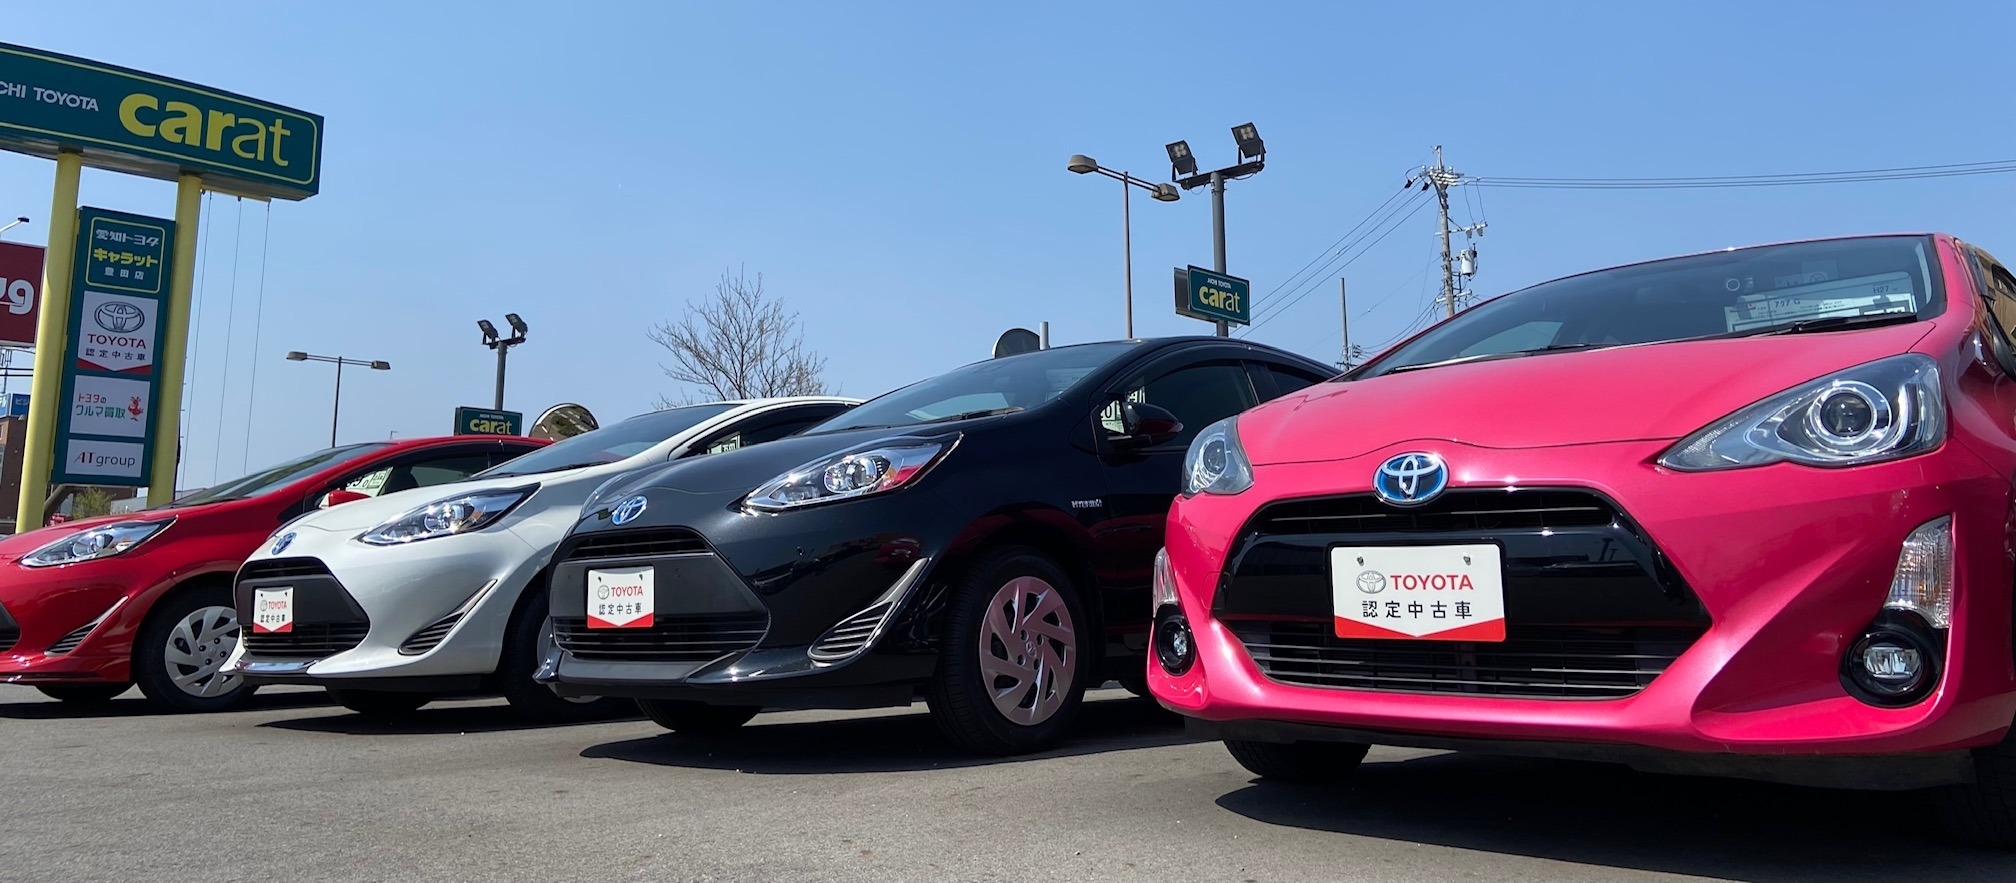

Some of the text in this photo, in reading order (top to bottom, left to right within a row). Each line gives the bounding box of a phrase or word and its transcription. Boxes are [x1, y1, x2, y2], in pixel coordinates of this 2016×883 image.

[33, 87, 99, 112] TOYOTA
[118, 93, 291, 167] carat
[96, 229, 159, 247] 愛知トヨタ
[94, 248, 158, 267] キャラット
[1199, 285, 1240, 313] carat
[87, 333, 147, 350] TOYOTA
[85, 348, 146, 361] 認定中古車
[78, 393, 107, 404] トヨタの
[75, 405, 126, 419] クルマ買取
[470, 418, 512, 435] carat
[1390, 574, 1474, 591] TOYOTA
[611, 586, 643, 597] TOYOTA
[268, 601, 287, 610] TOYOTA
[598, 602, 642, 615] 認定中古車
[1362, 600, 1472, 619] 認定中古車
